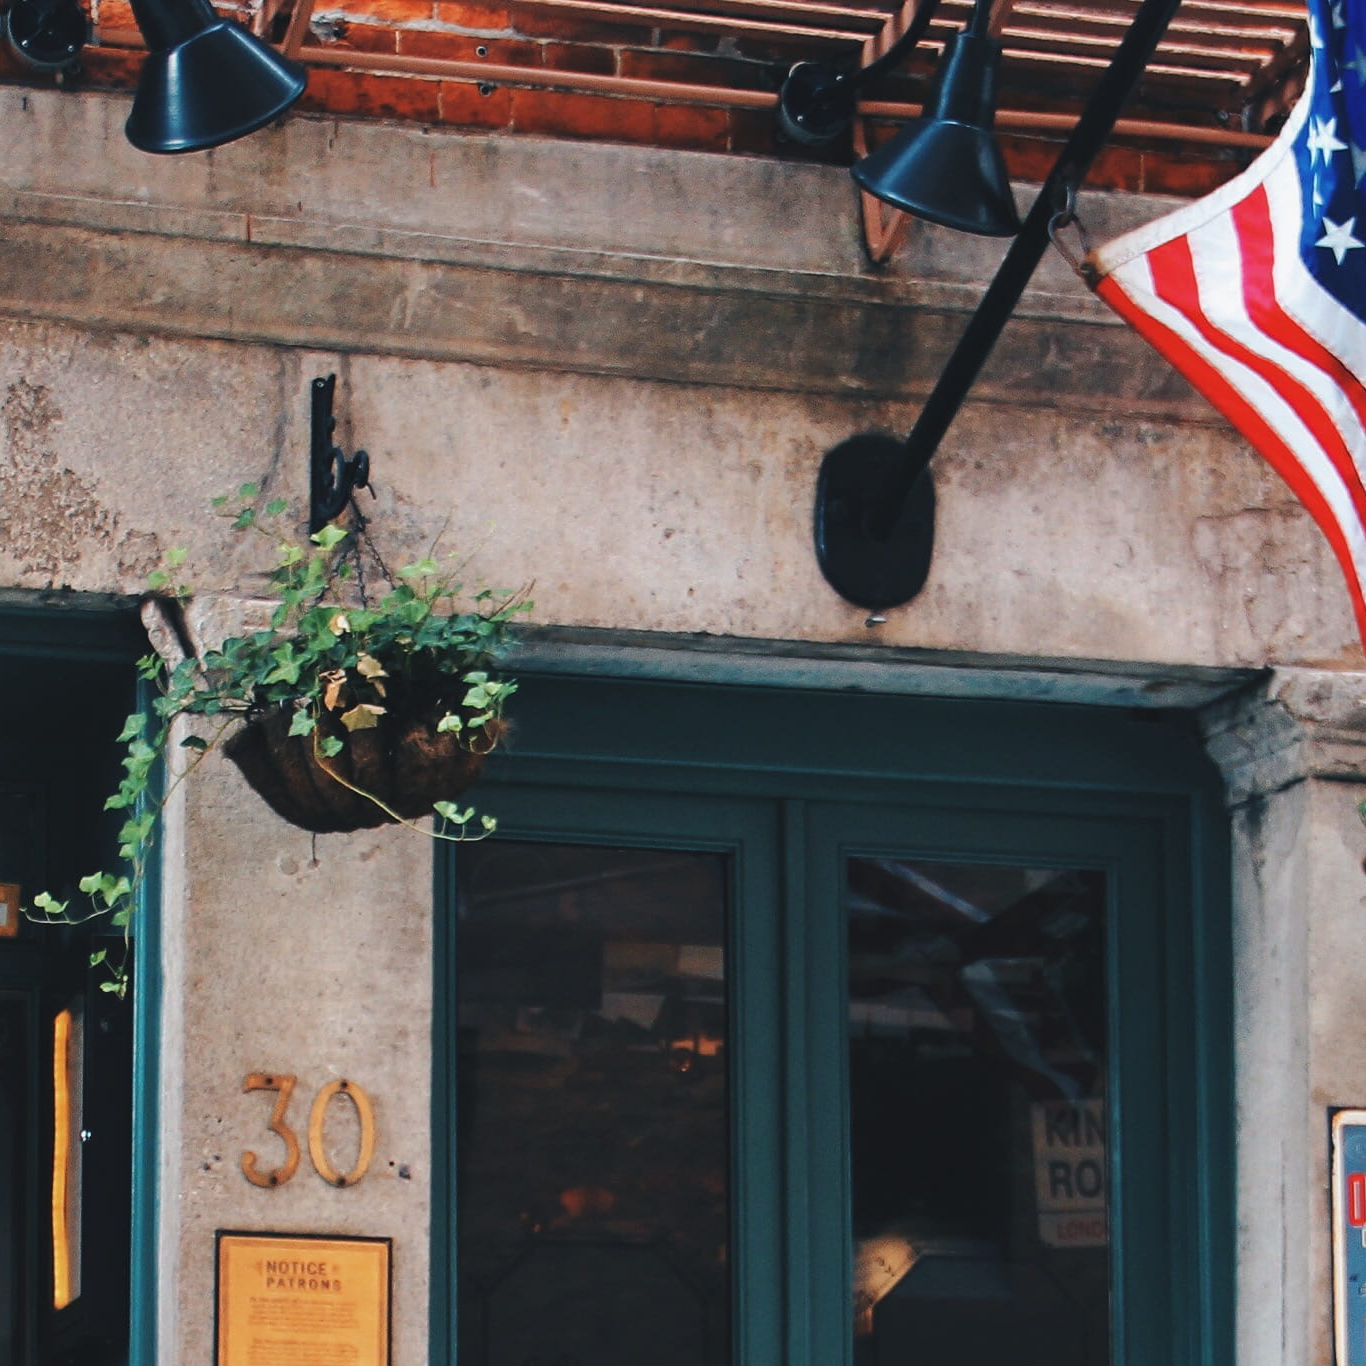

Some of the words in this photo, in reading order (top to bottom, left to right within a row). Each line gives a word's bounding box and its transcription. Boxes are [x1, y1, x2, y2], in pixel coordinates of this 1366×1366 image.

[241, 1071, 376, 1188] 30
[266, 1260, 327, 1276] NOTICE
[266, 1277, 341, 1292] PATRONS
